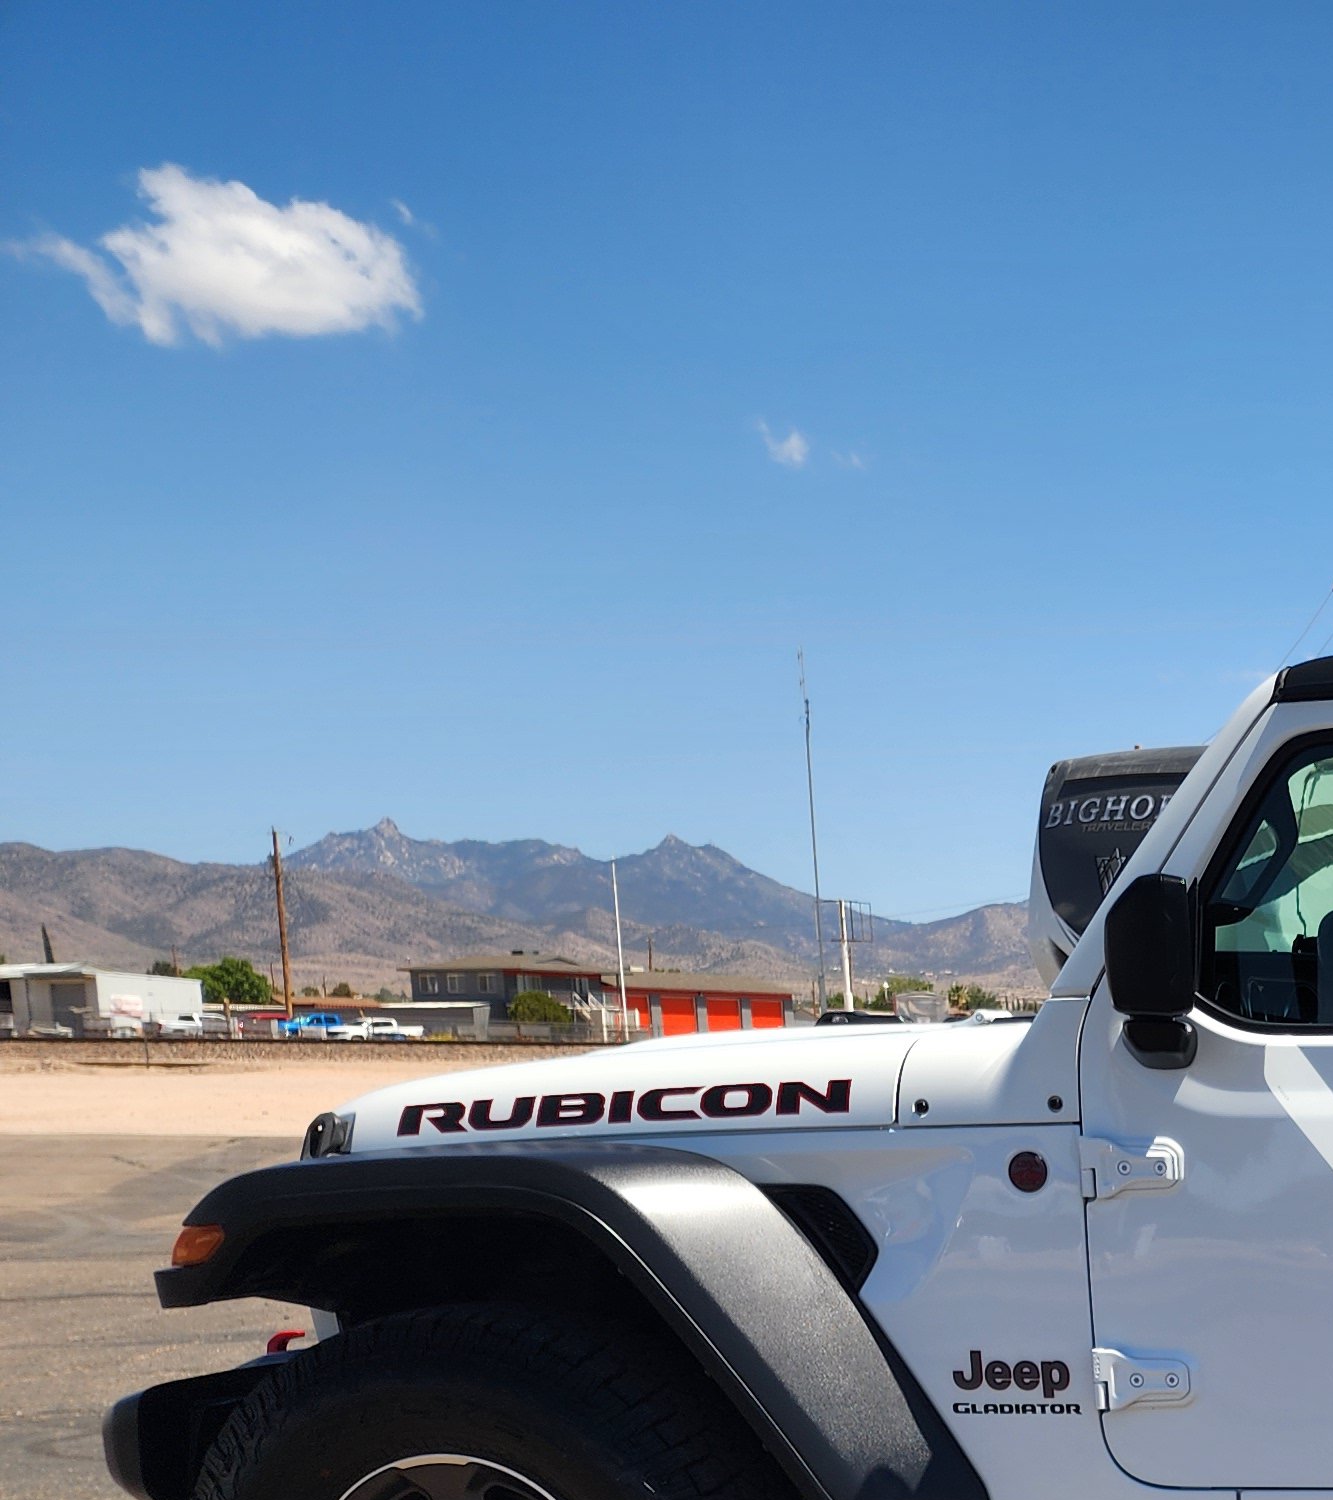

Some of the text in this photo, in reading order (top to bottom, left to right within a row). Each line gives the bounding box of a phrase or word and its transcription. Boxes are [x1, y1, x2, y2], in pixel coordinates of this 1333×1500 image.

[397, 1079, 852, 1137] RUBICON
[952, 1350, 1070, 1398] Jeep
[952, 1402, 1082, 1415] GLADIATOR
